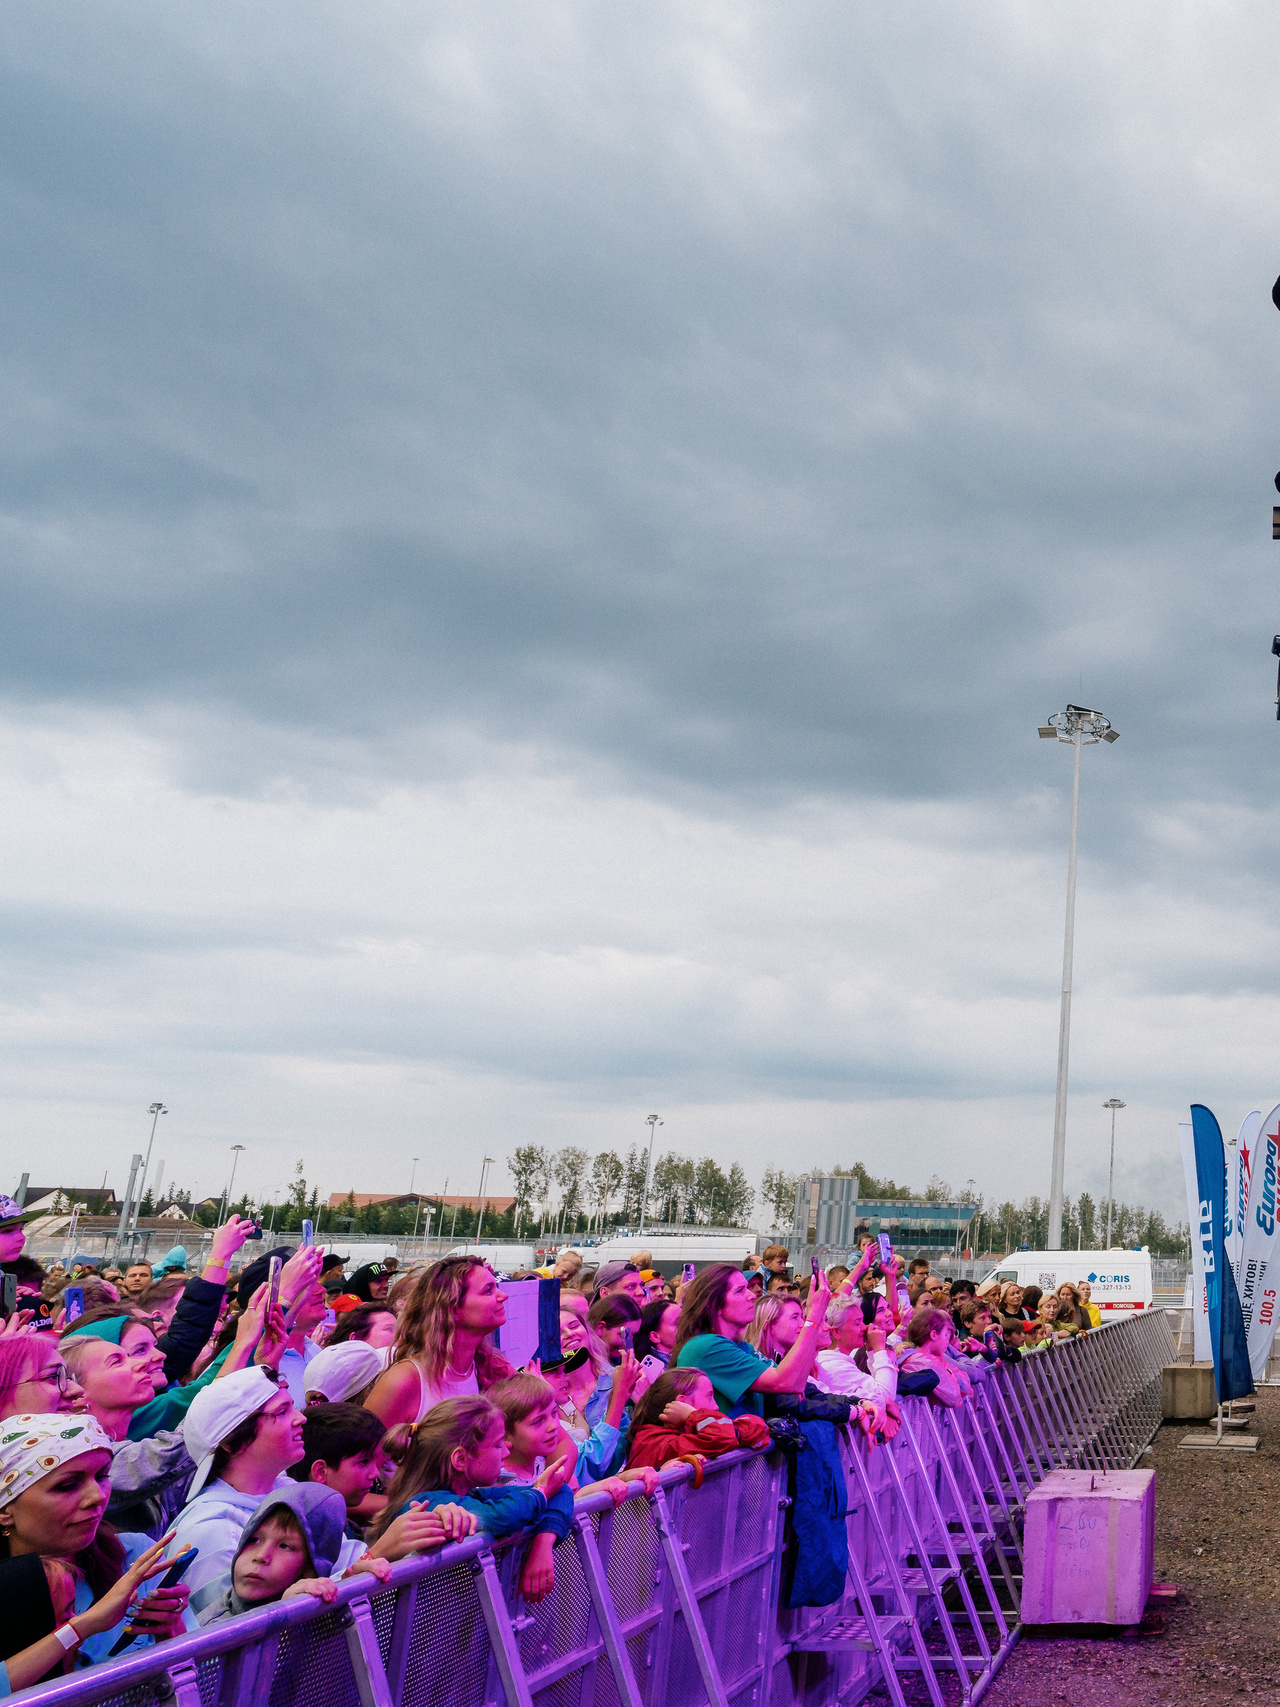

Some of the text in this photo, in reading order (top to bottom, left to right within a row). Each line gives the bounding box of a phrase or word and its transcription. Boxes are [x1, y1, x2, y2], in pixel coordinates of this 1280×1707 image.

[1099, 1275, 1130, 1283] CORIS
[1243, 1258, 1259, 1300] ХИТОВ!
[1259, 1289, 1277, 1326] 100.5
